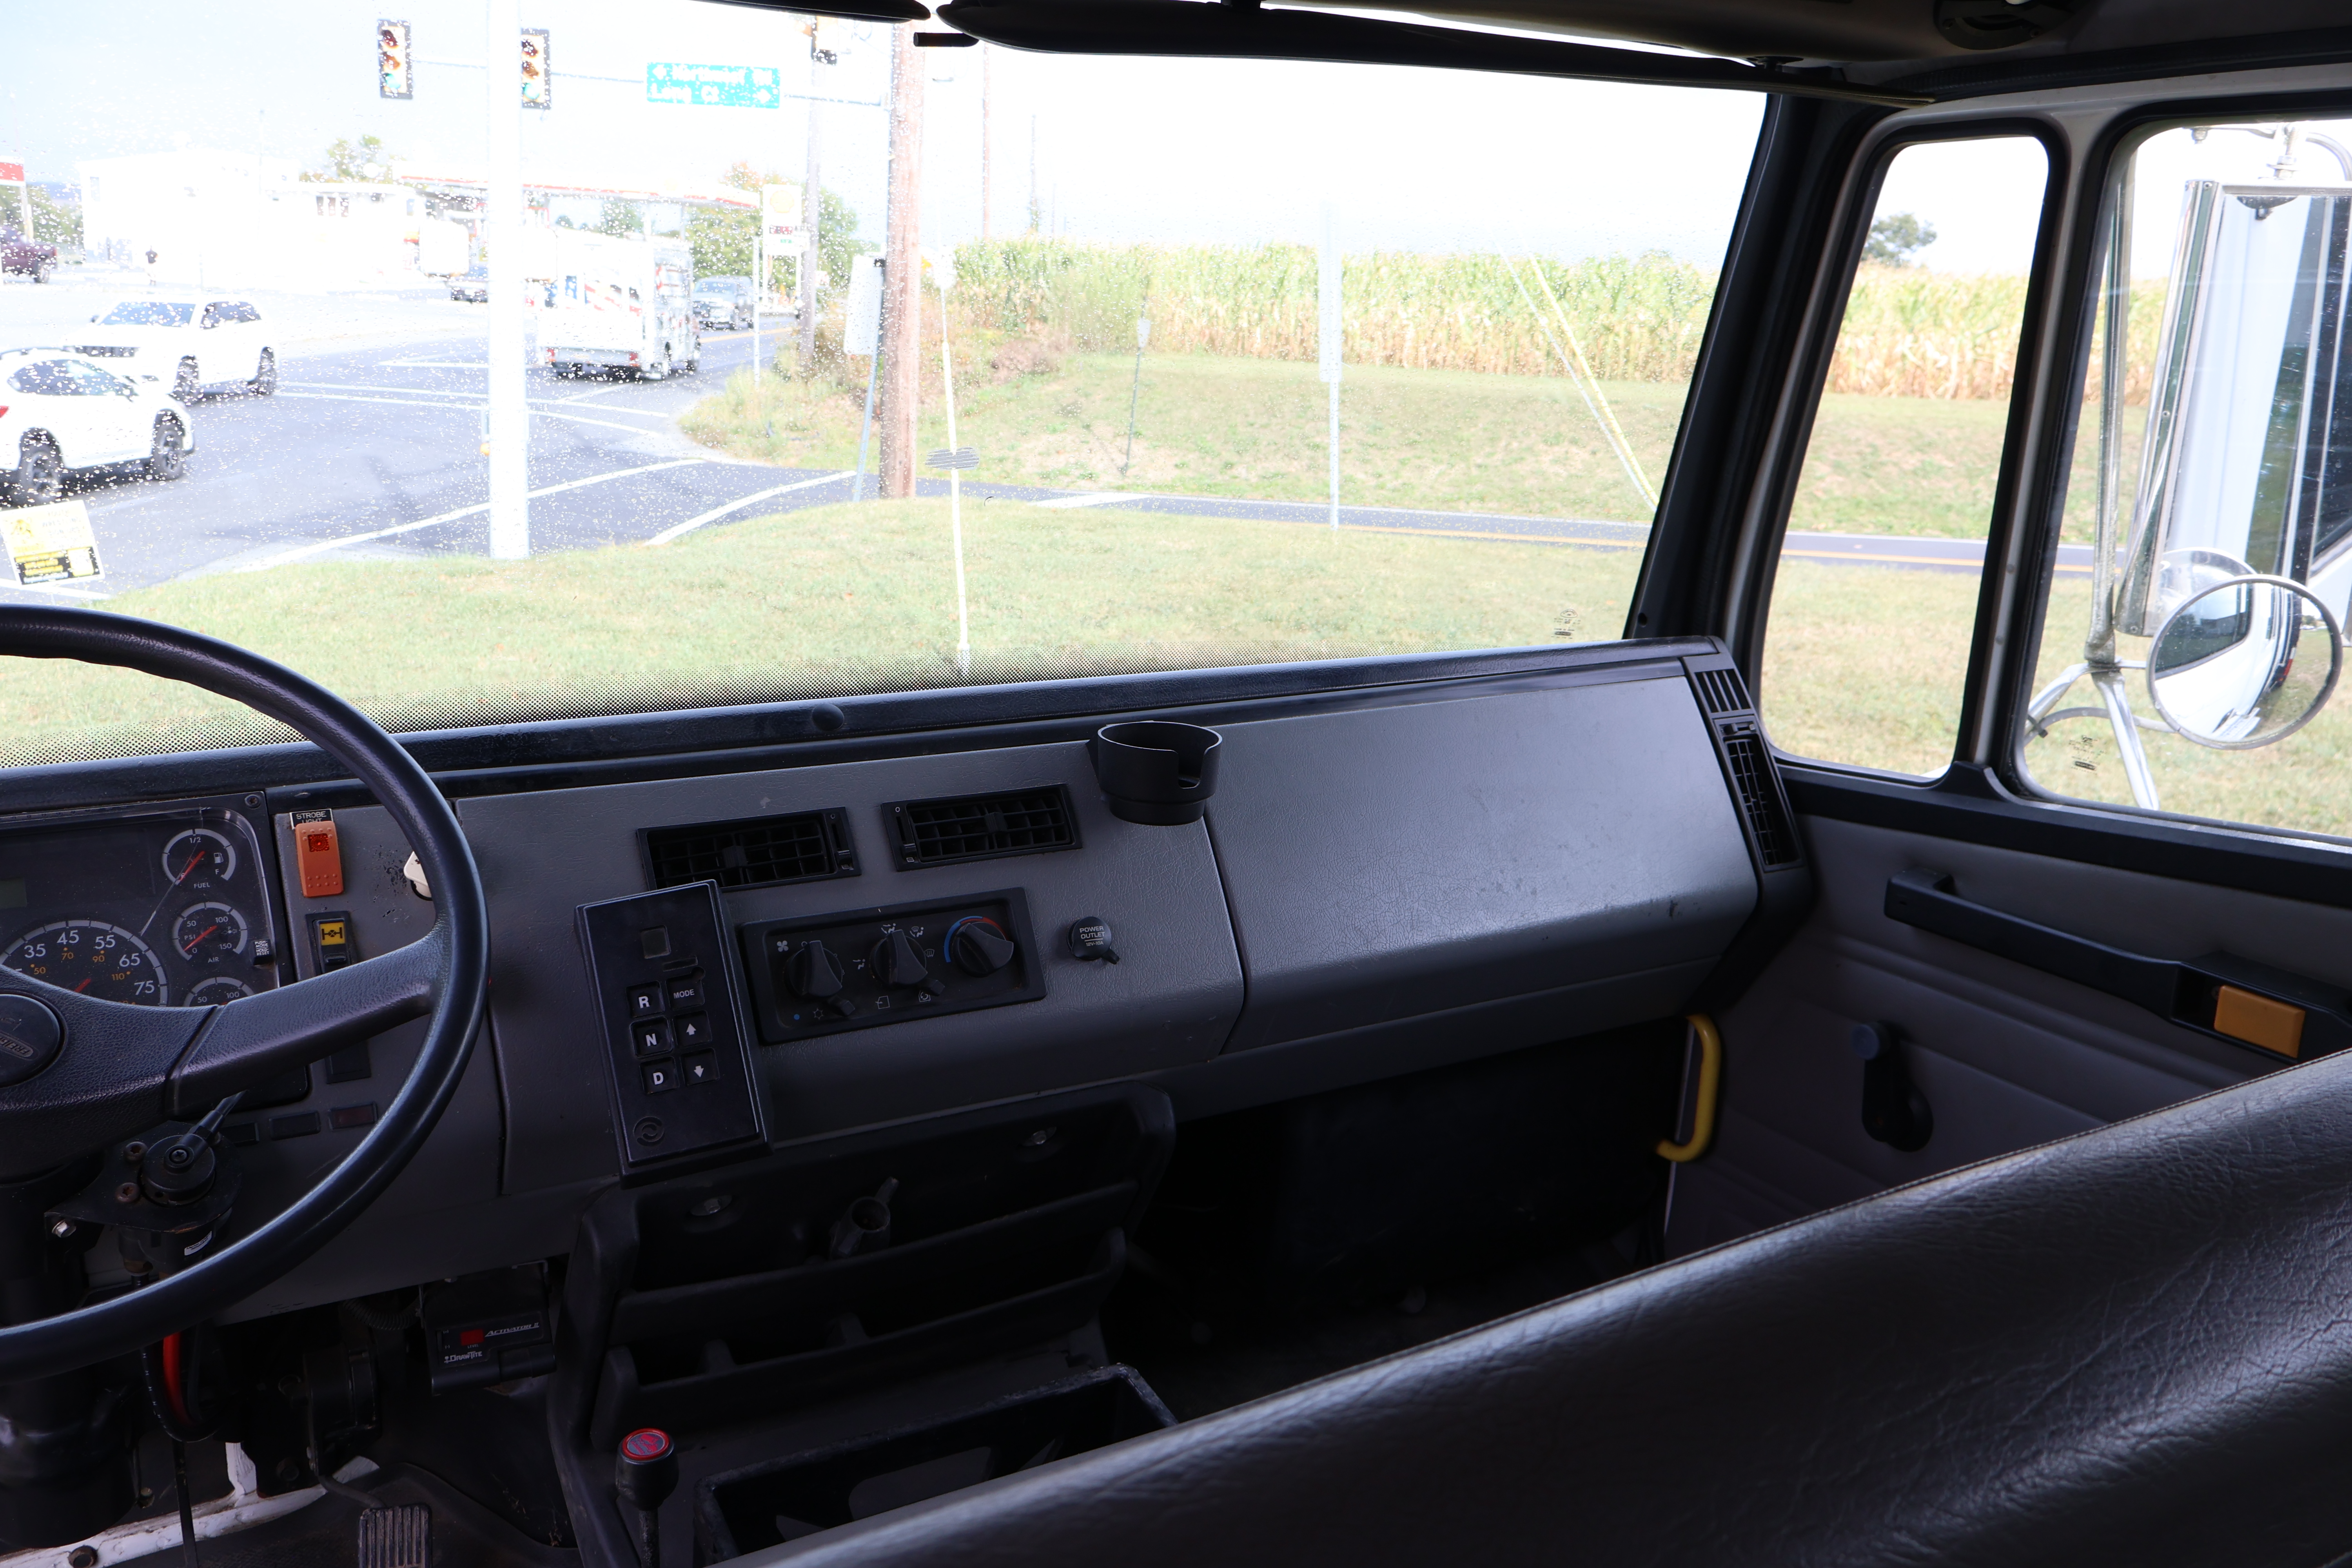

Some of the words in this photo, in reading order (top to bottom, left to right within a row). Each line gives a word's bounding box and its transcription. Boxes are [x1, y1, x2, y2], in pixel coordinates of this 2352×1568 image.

[296, 811, 327, 819] STROBE
[57, 930, 79, 944] 45
[94, 935, 116, 949] 55
[24, 943, 46, 958] 35
[119, 953, 140, 967] 65
[134, 980, 155, 995] 75
[673, 989, 695, 999] MODE
[638, 996, 650, 1009] R
[0, 1037, 31, 1054] FREIG
[646, 1033, 657, 1046] N
[653, 1072, 664, 1085] D
[486, 1324, 532, 1336] ACTIVATOR
